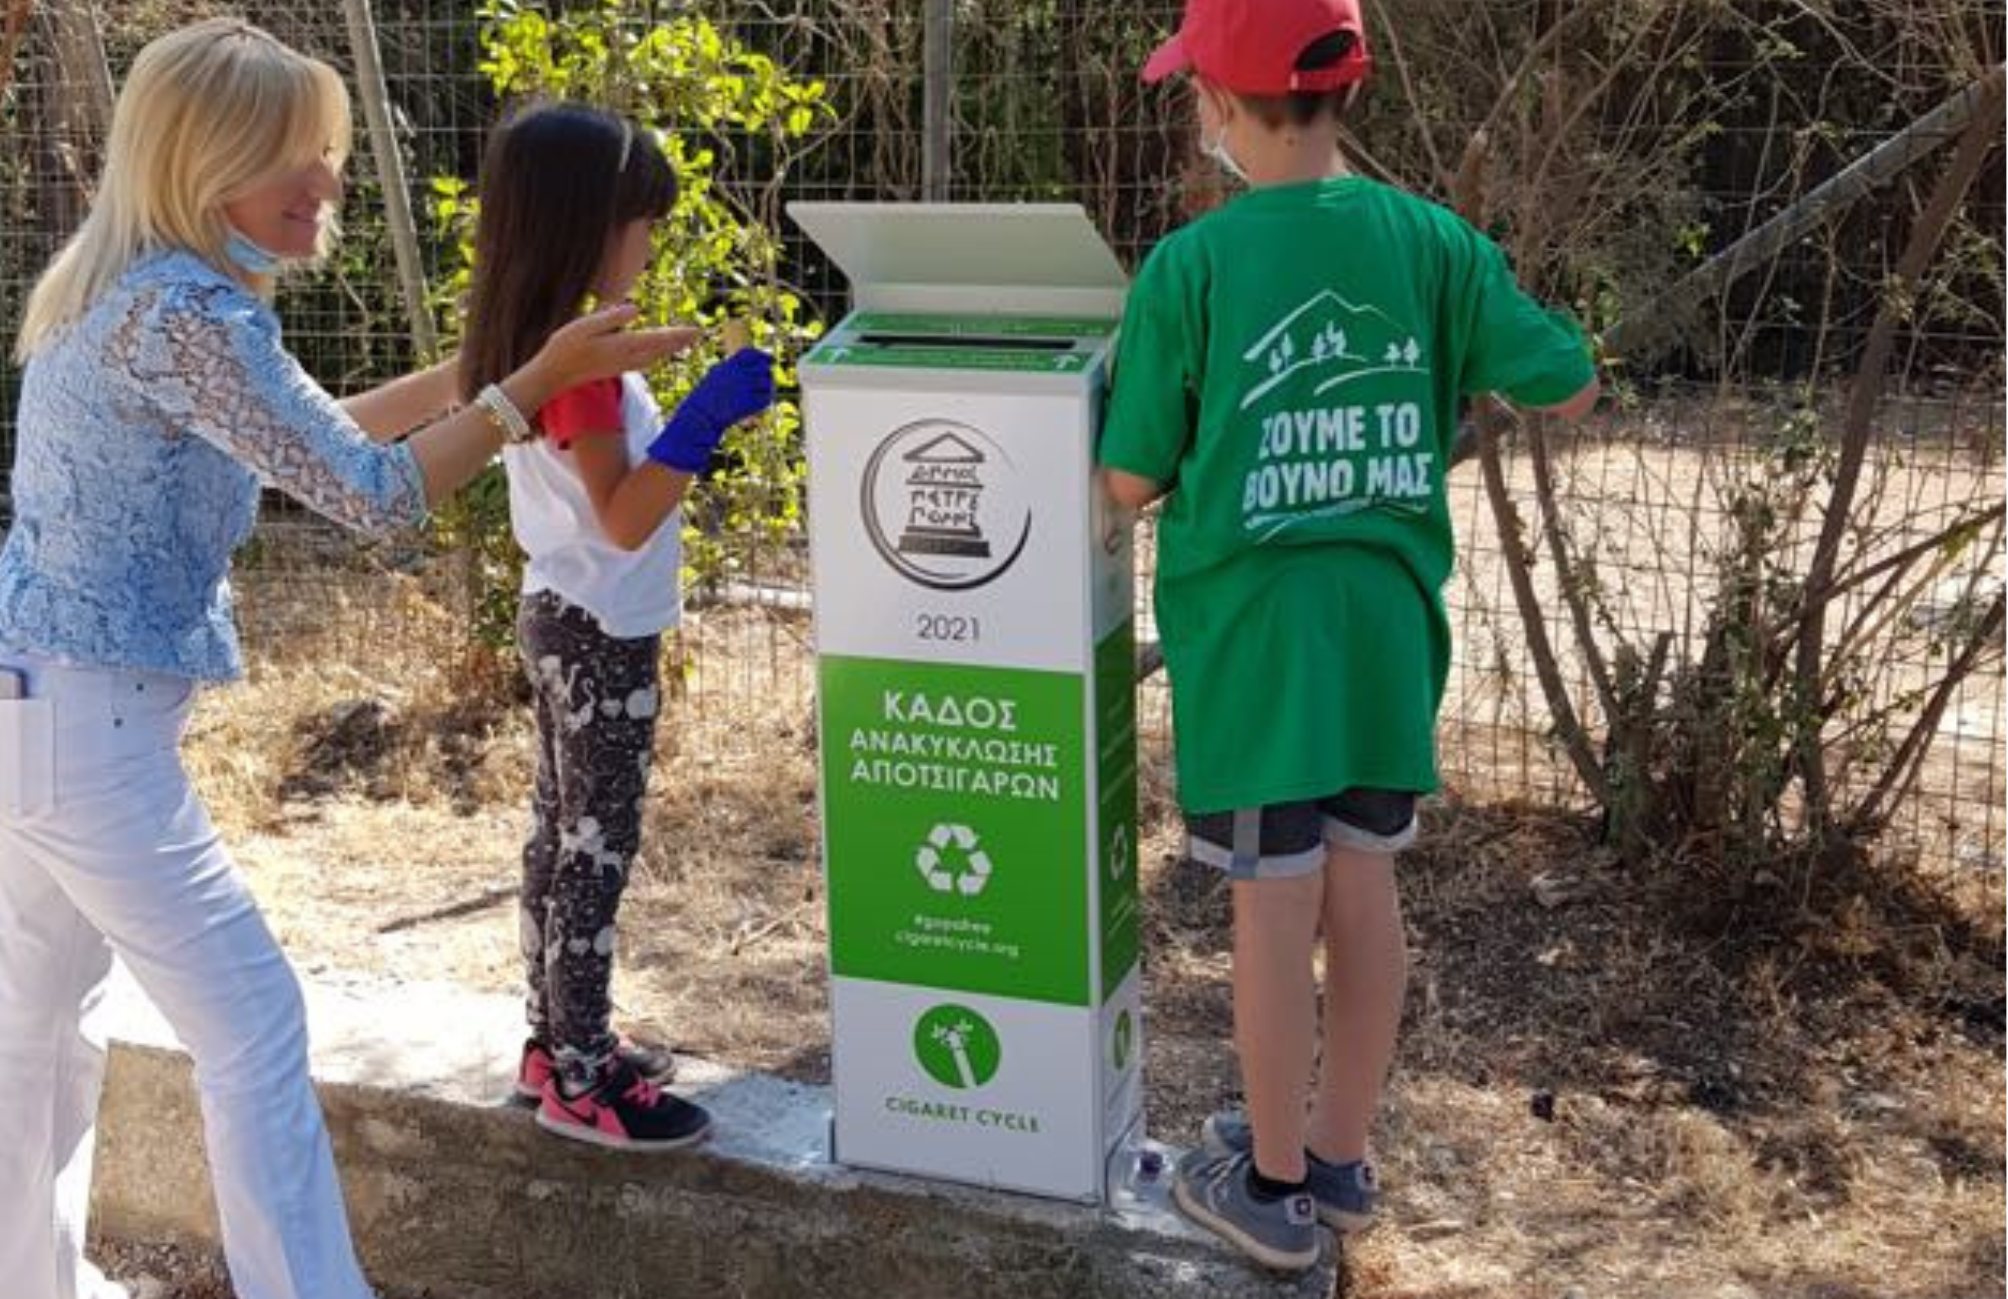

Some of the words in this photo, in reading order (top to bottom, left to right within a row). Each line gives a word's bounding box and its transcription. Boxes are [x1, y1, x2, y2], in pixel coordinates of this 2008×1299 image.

[1376, 402, 1421, 448] ΤΟ
[1243, 459, 1354, 512] ΒΟΥΝΟ
[1365, 452, 1434, 498] ΜΑΣ
[917, 614, 980, 641] 2021
[884, 690, 1016, 730] ΚΑΔΟΣ
[850, 728, 1058, 767] ΑΝΑΚΥΚΛΩΣΗΣ
[850, 759, 1060, 800] ΑΠΟΤΣΙΓΑΡΩΝ
[885, 1096, 971, 1122] CIGARET
[976, 1109, 1040, 1133] CYCLE
